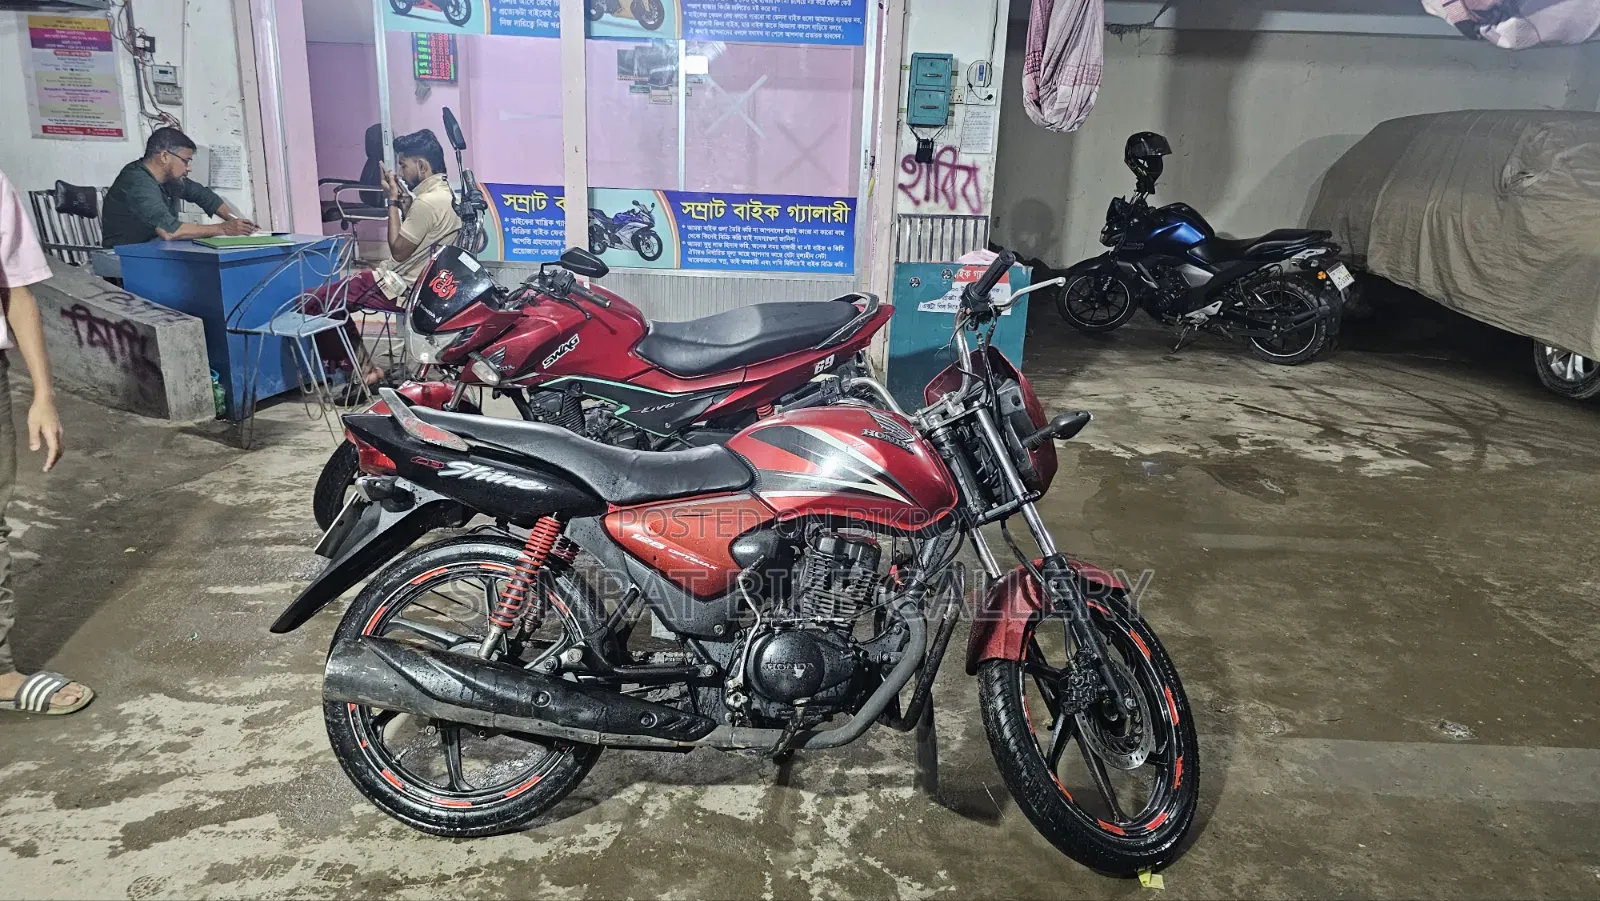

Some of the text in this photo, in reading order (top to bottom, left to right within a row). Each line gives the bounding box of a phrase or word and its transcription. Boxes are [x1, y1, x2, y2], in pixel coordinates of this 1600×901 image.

[500, 189, 549, 214] সম্রাট
[680, 196, 852, 224] সম্রাট বাইক গ্যালারী
[542, 333, 580, 370] SWAG
[813, 354, 835, 375] 69
[861, 428, 915, 455] HONDA
[668, 548, 718, 571] OPTIMAX
[765, 661, 816, 671] HONDA
